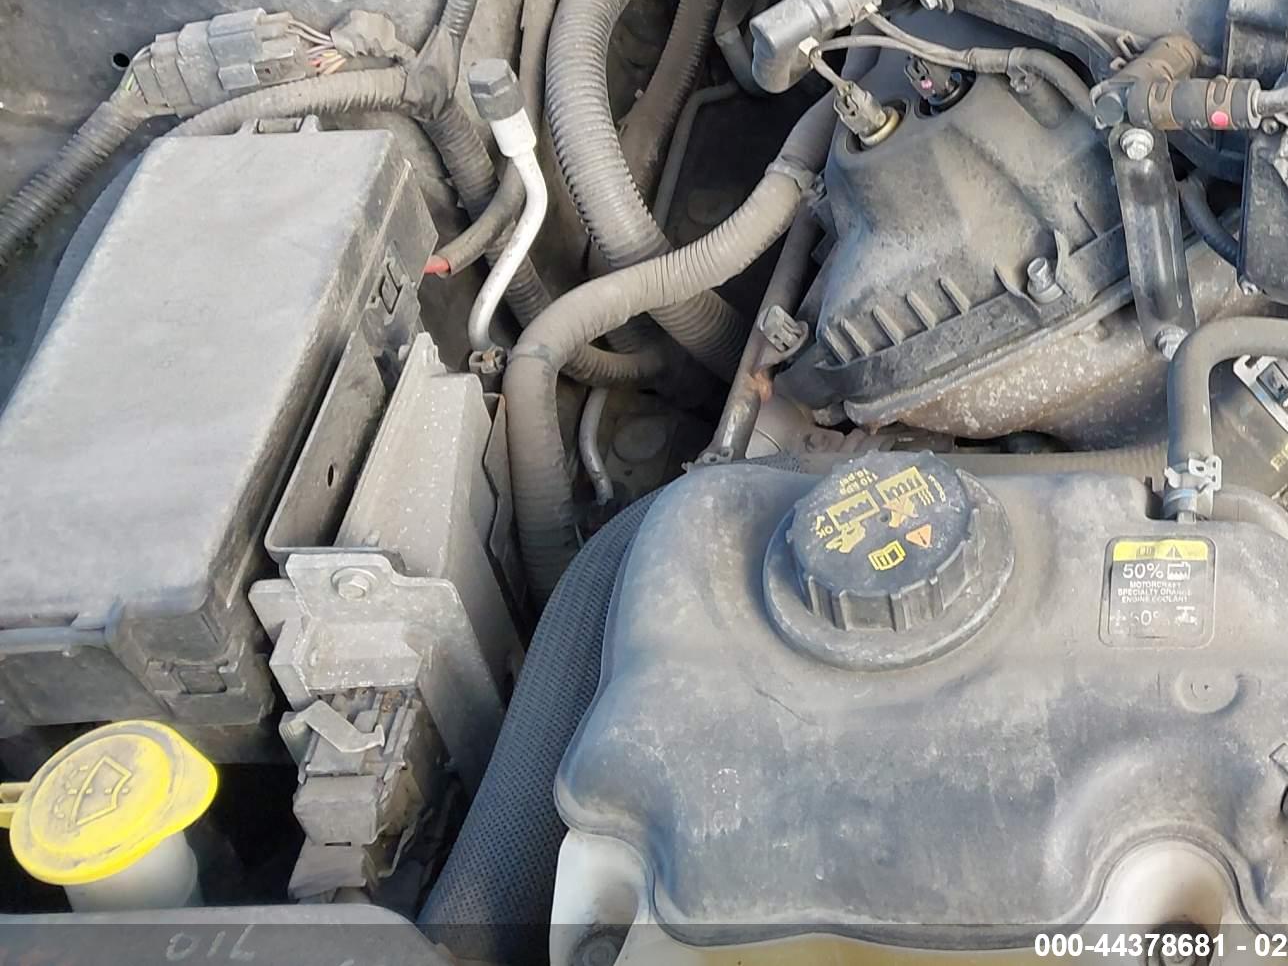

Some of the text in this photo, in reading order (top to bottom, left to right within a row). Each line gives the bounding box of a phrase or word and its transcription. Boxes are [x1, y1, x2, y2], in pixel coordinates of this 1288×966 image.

[815, 525, 834, 539] OK
[1122, 562, 1165, 580] 50%
[1129, 580, 1182, 589] MOTORCRAFT
[1117, 588, 1159, 597] SPECIALTY
[165, 922, 257, 962] OIL
